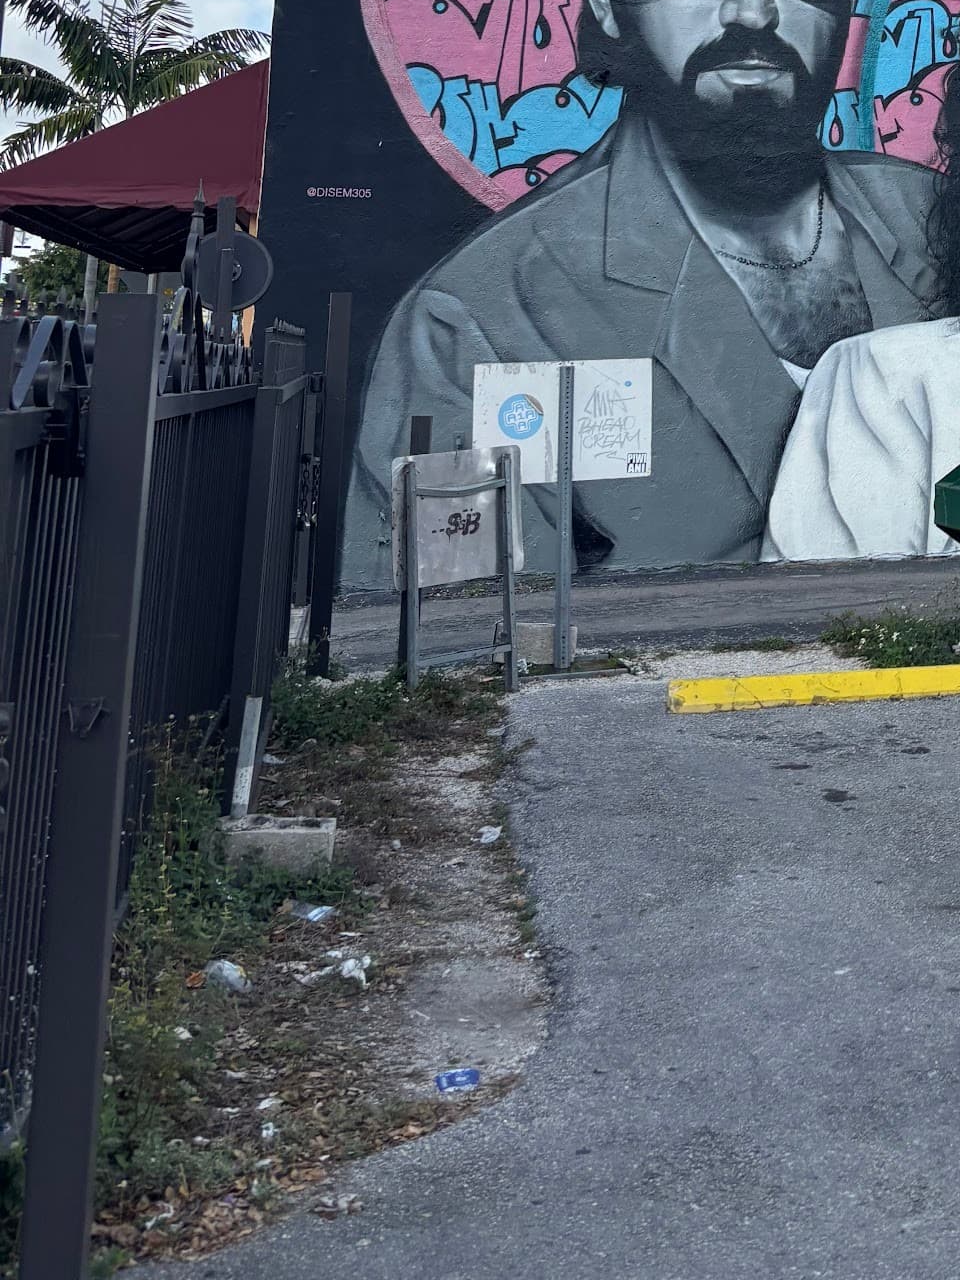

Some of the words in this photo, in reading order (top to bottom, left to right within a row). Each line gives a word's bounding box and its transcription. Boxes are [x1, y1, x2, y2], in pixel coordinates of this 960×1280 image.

[306, 186, 372, 198] @DISEM305
[582, 428, 641, 450] CREAM
[627, 453, 647, 464] PIWI
[627, 463, 647, 473] ANI
